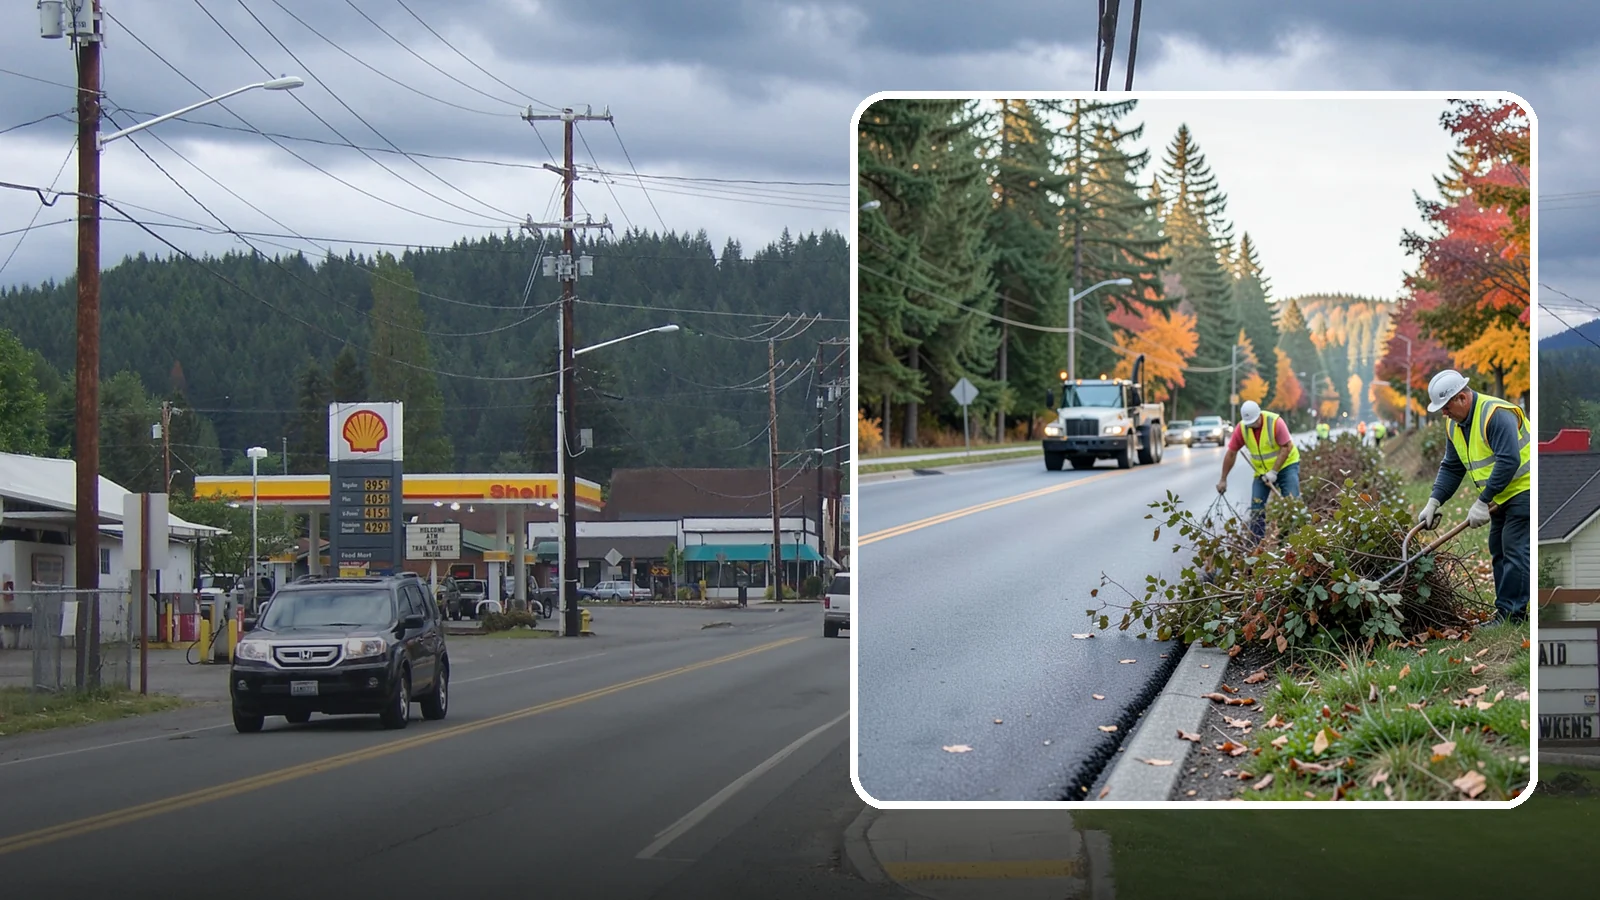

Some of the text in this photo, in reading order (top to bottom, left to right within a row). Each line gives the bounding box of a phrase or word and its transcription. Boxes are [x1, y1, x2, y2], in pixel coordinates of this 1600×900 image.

[366, 480, 383, 490] 395
[490, 484, 547, 499] Shell
[366, 494, 383, 504] 405
[365, 508, 383, 518] 415
[366, 522, 383, 532] 429
